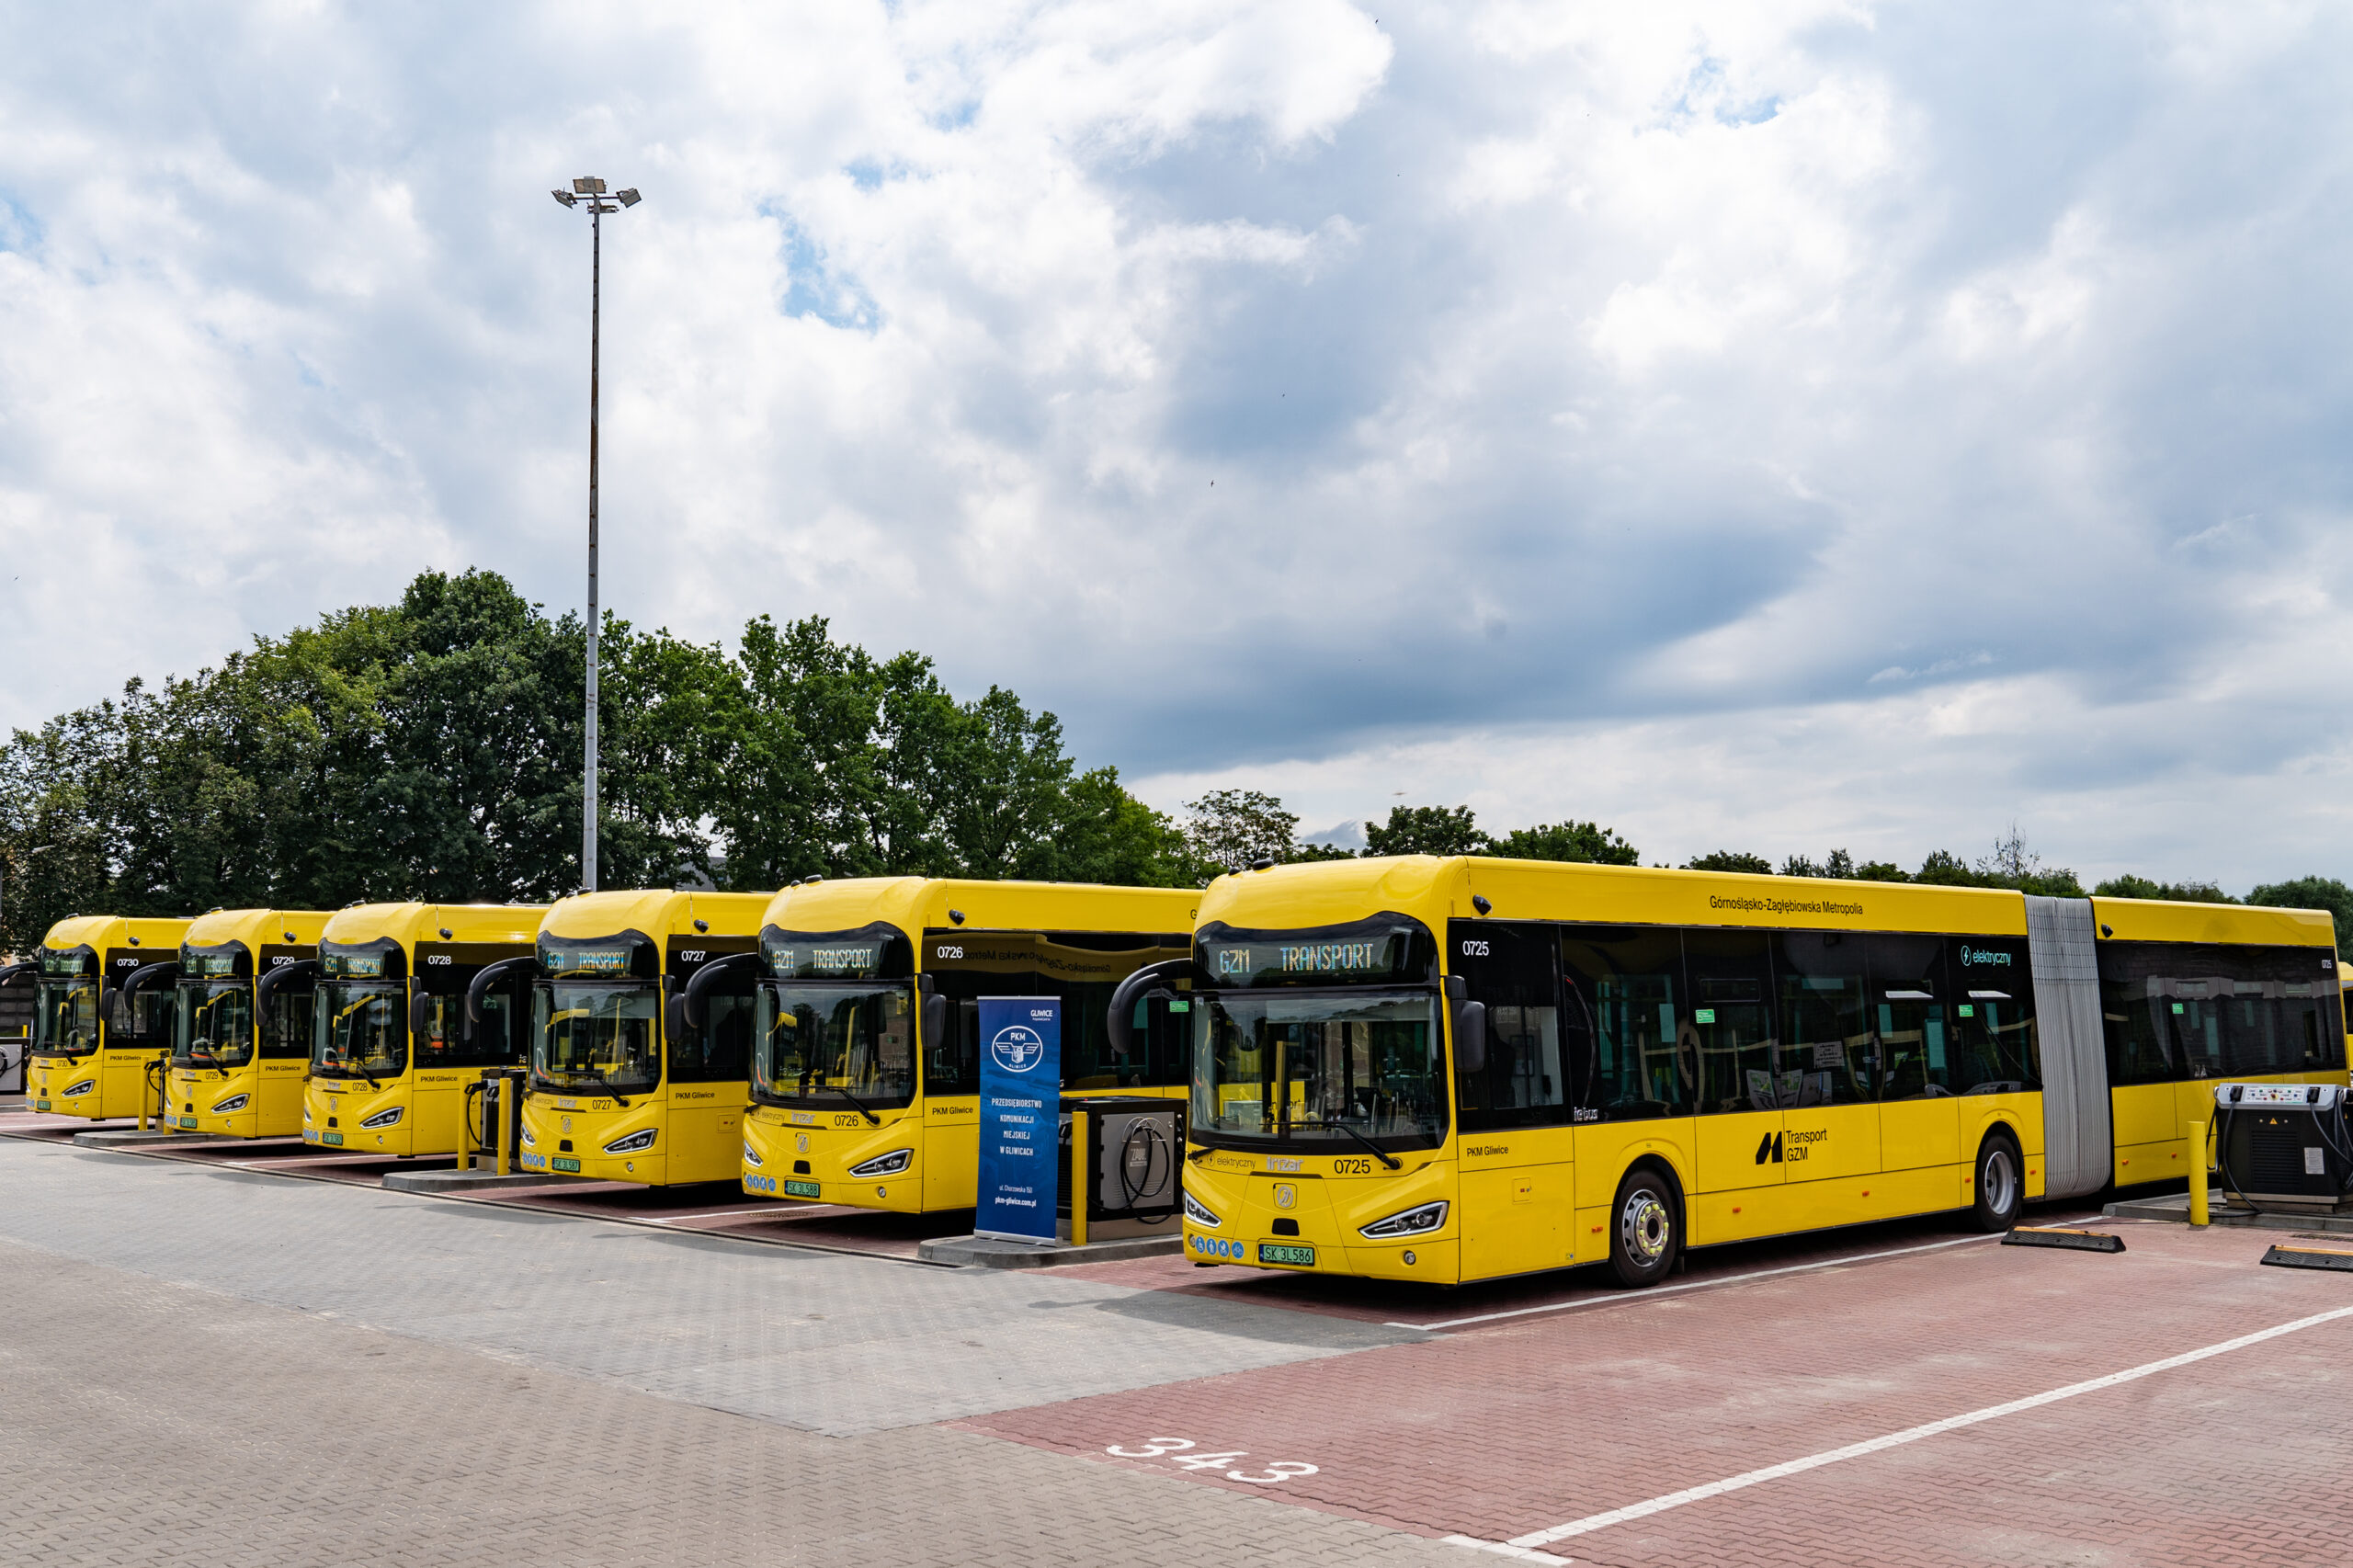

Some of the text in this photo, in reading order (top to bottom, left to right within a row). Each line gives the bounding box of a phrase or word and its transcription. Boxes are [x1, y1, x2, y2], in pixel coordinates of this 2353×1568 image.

[1710, 895, 1863, 916] Górnośląsko-Zagłębiowska Metropolia
[937, 946, 963, 959] 0726
[1462, 940, 1490, 957] 0725
[272, 956, 295, 966] 0729
[427, 955, 452, 965] 0728
[578, 951, 625, 970] TRANSPORT
[681, 950, 706, 961] 0727
[773, 949, 872, 969] GZM TRANSPORT
[1220, 943, 1374, 974] GZM TRANSPORT
[1972, 949, 2011, 966] elektryczny
[117, 959, 140, 967] 0730
[1030, 1009, 1053, 1017] GLIWICE
[1010, 1032, 1026, 1041] PKM
[205, 1072, 219, 1080] 0729
[352, 1083, 368, 1092] 0728
[691, 1091, 715, 1099] Gliwice
[592, 1099, 611, 1110] 0727
[991, 1097, 1042, 1108] PRZEDSIĘBIORSTWO
[932, 1106, 974, 1115] PKM Gliwice
[834, 1114, 859, 1127] 0726
[999, 1114, 1035, 1124] KOMUNIKACJI
[1003, 1130, 1030, 1140] MIEJSKIEJ
[1785, 1128, 1827, 1145] Transport
[999, 1145, 1034, 1156] W GLIWICACH
[1466, 1145, 1509, 1157] PKM Gliwice
[1786, 1146, 1809, 1162] GZM
[1216, 1156, 1256, 1169] elektryczny
[1334, 1159, 1371, 1175] 0725
[789, 1182, 818, 1195] SK 3L588
[995, 1196, 1037, 1208] pkm-gliwice.com.pl
[1265, 1246, 1311, 1262] SK 3L586
[1106, 1437, 1320, 1483] 343
